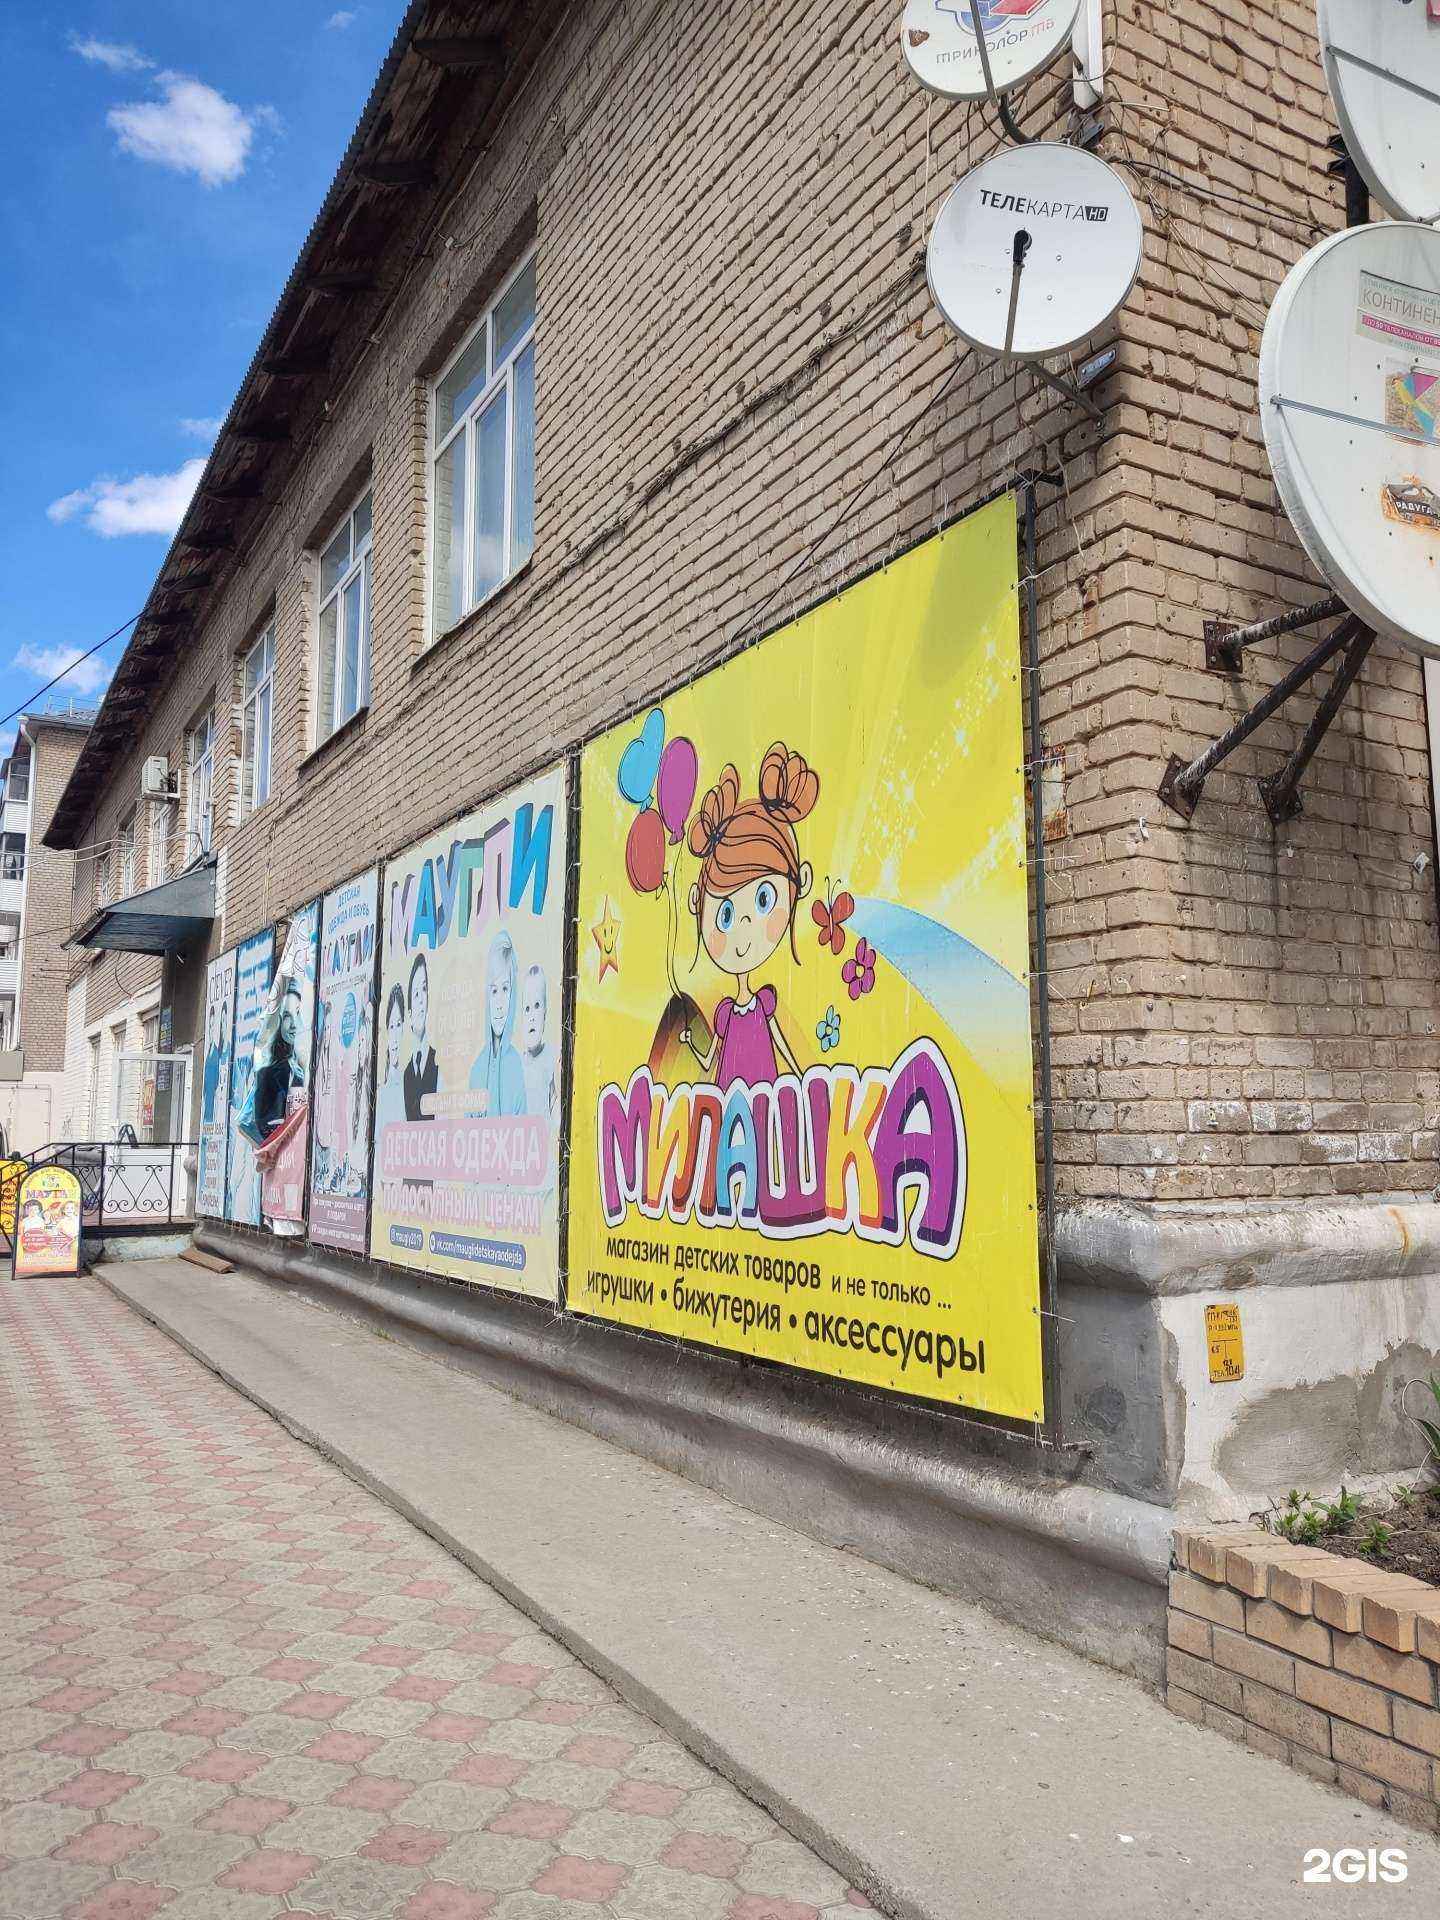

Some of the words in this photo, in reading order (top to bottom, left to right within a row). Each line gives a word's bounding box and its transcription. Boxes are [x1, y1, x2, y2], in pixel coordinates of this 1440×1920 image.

[980, 189, 1085, 221] ТЕЛЕКАРТА
[390, 802, 554, 957] МАУГЛИ
[321, 922, 375, 978] МАУГЛИ
[383, 1130, 447, 1172] ДЕТСКАЯ
[451, 1126, 540, 1178] ОДЕЖДА
[600, 1038, 965, 1260] МИЛАШКА
[606, 1236, 670, 1266] магазин
[673, 1244, 739, 1277] детских
[744, 1254, 821, 1294] товаров
[831, 1274, 842, 1294] и
[846, 1277, 866, 1298] не
[870, 1279, 931, 1307] только
[587, 1269, 654, 1306] игрушки
[673, 1276, 781, 1336] бижутерия
[804, 1310, 986, 1379] аксессуары
